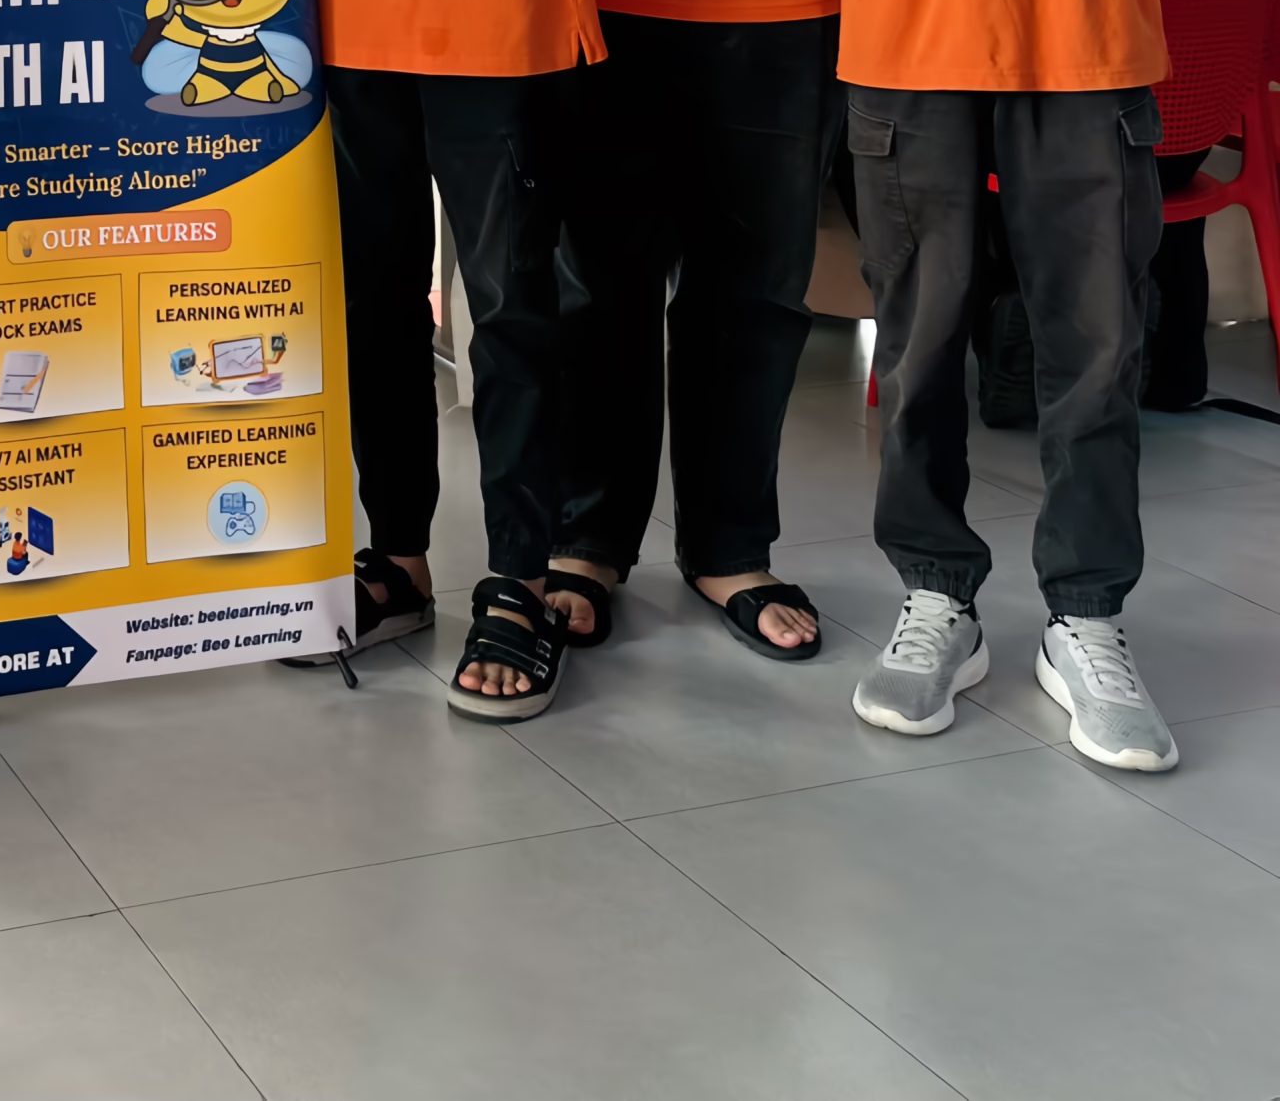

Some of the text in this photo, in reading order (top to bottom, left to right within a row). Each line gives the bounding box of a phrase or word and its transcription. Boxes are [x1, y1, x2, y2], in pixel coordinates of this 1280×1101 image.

[59, 40, 105, 104] AI
[5, 143, 92, 163] Smarter
[118, 137, 179, 157] Score
[186, 135, 262, 159] Higher
[26, 172, 123, 199] Studying
[42, 222, 218, 250] OUR FEATURES
[169, 278, 292, 298] PERSONALIZED
[20, 292, 97, 312] PRACTICE
[156, 301, 304, 323] LEARNING WITH AI
[29, 318, 83, 337] EXAMS
[153, 422, 317, 448] GAMIFIED LEARNING
[15, 448, 32, 464] AI
[35, 443, 83, 462] MATH
[186, 450, 287, 471] EXPERIENCE
[126, 600, 314, 634] Website: beelearning.vn
[46, 646, 75, 667] AT
[126, 628, 303, 663] Fanpage: Bee Learning
